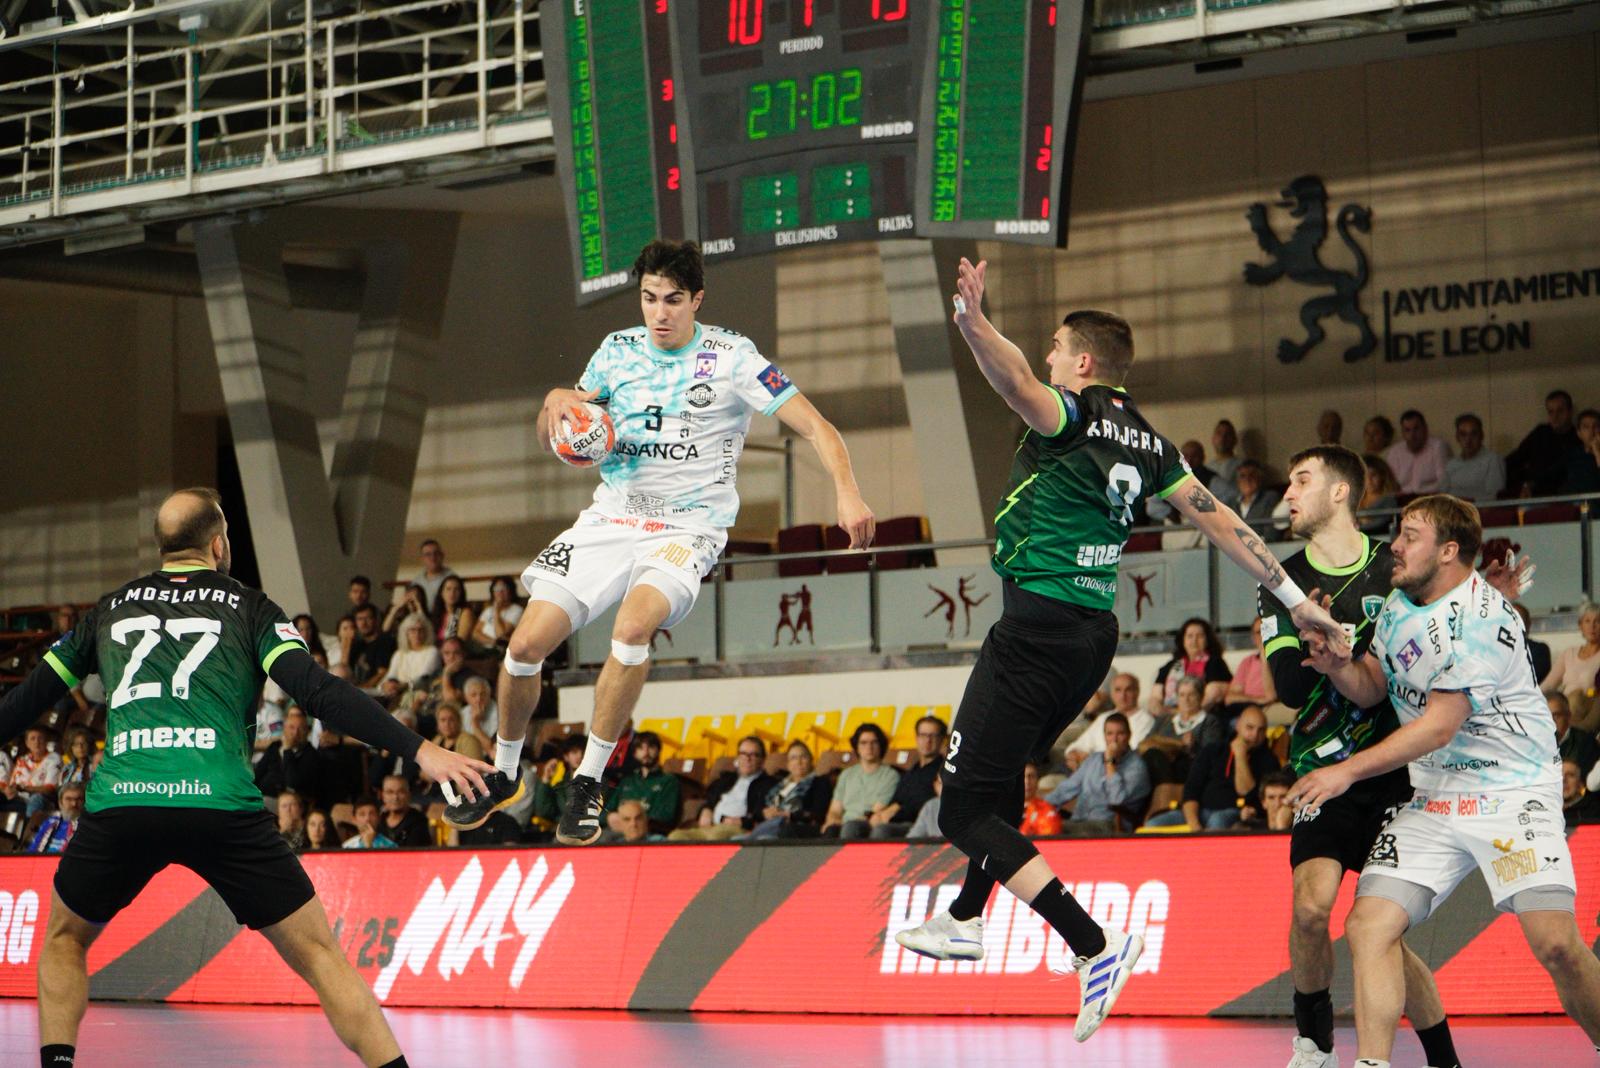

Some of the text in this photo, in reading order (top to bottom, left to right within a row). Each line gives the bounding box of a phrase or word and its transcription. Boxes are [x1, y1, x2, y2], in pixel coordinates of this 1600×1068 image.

[728, 0, 762, 45] 10
[747, 69, 863, 140] 27:02
[861, 121, 914, 139] MONDO
[878, 215, 914, 232] FALTAS
[995, 220, 1050, 235] MONDO
[702, 237, 735, 255] FALTAS
[581, 271, 628, 294] MONDO
[1391, 313, 1531, 363] DE LEÓN
[644, 404, 663, 432] 3
[573, 424, 606, 453] SELECT
[111, 614, 222, 710] 27
[130, 726, 217, 751] nexe
[112, 779, 213, 799] enosophia
[372, 854, 576, 1001] MAY
